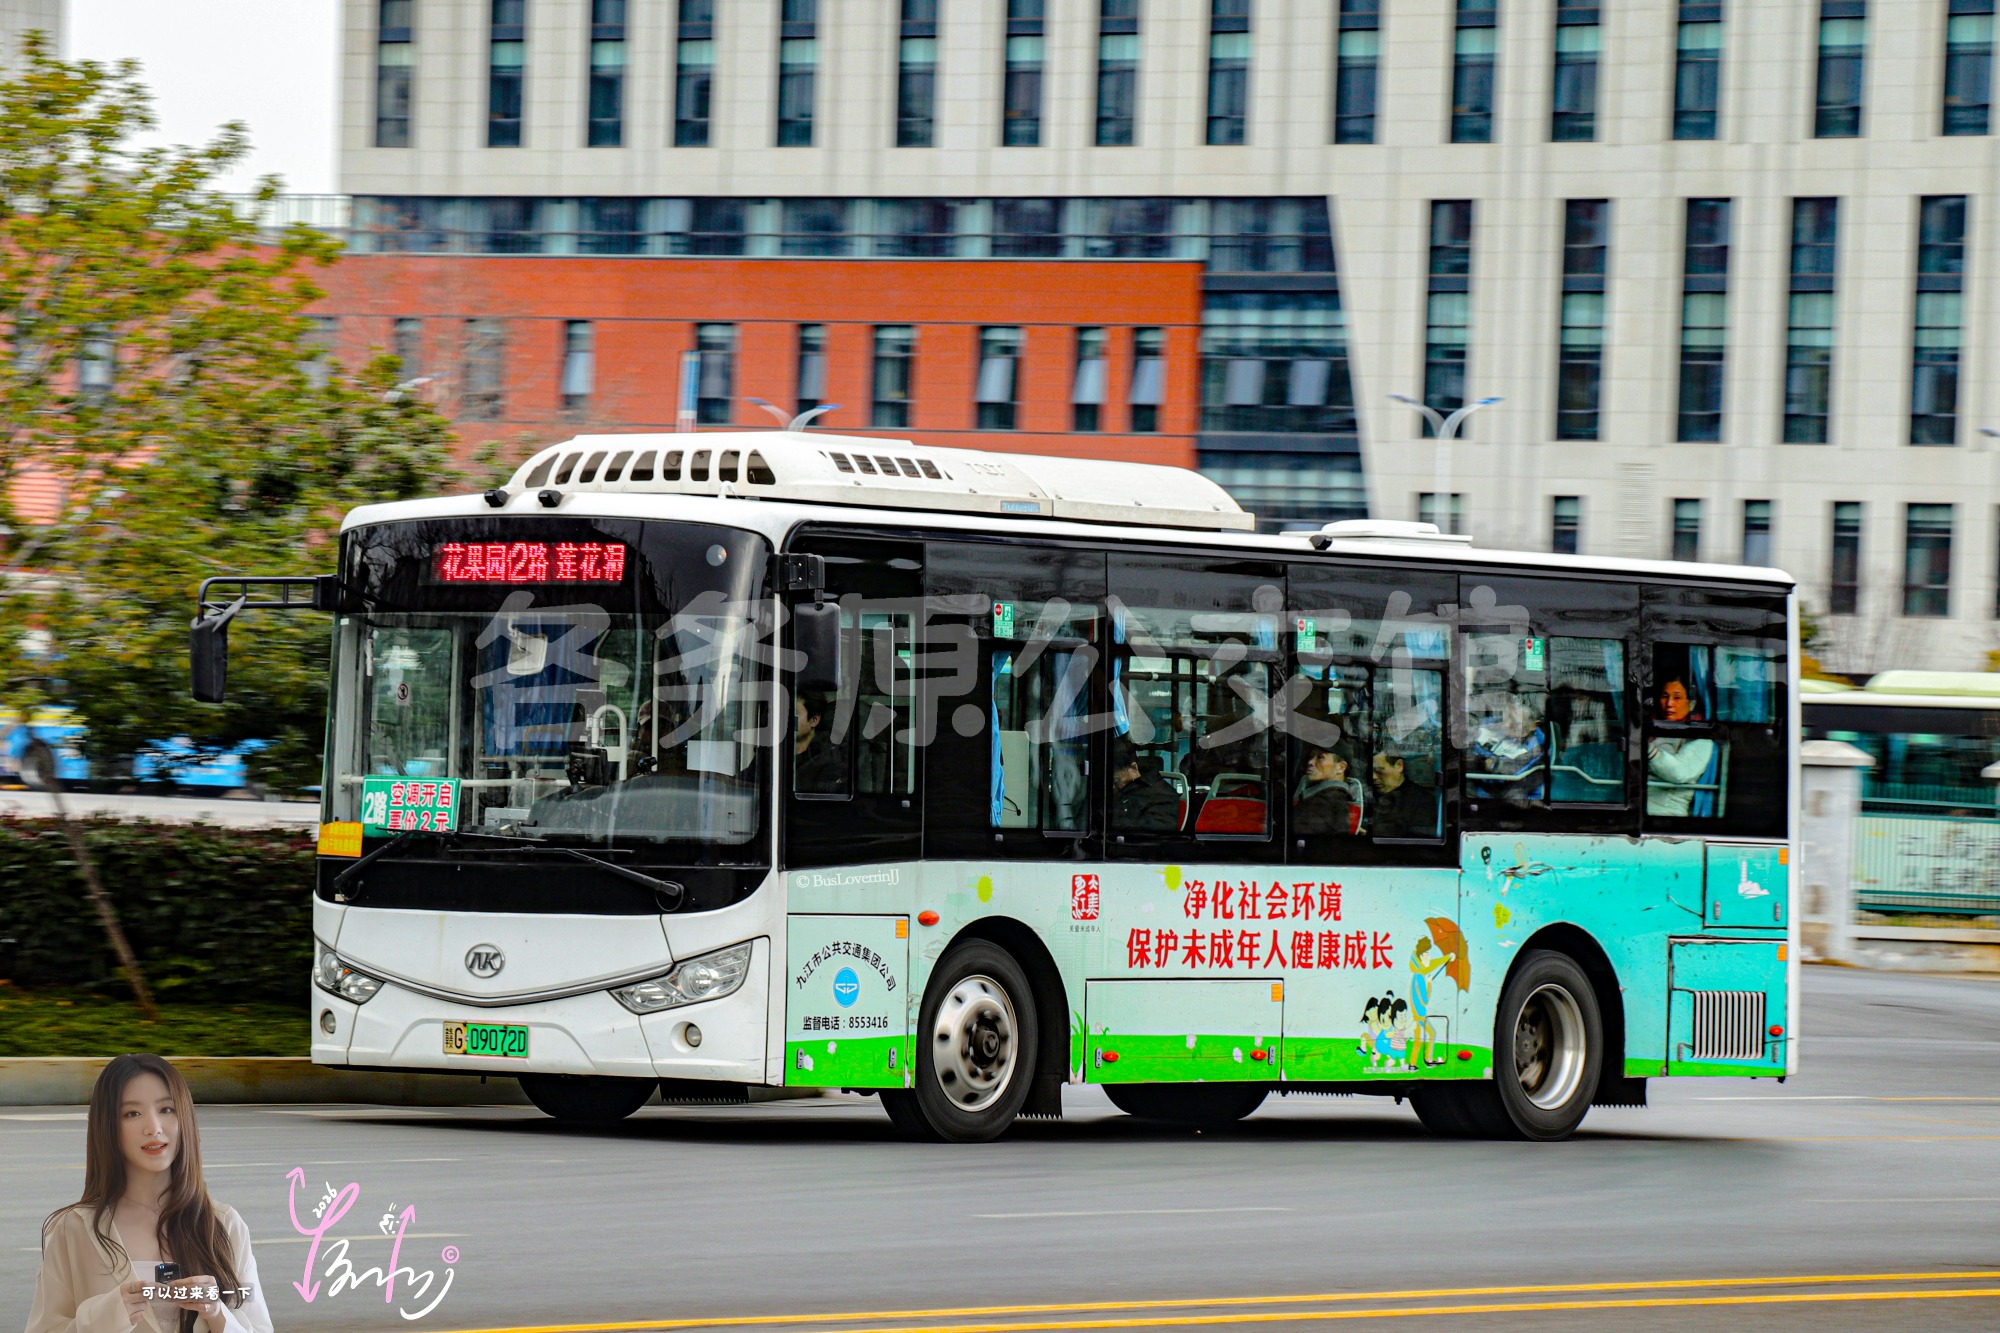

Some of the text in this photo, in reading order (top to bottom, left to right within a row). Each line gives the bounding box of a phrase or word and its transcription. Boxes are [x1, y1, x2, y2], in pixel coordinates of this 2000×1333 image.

[443, 542, 549, 581] 花果园2路
[364, 791, 388, 825] 2路
[389, 782, 454, 808] 空调开启
[387, 810, 450, 833] 票价2元
[1183, 880, 1342, 921] 净化社会环境
[796, 940, 897, 991] 九江市公共交通集团公司
[1126, 928, 1394, 970] 保护未成年人健康成长
